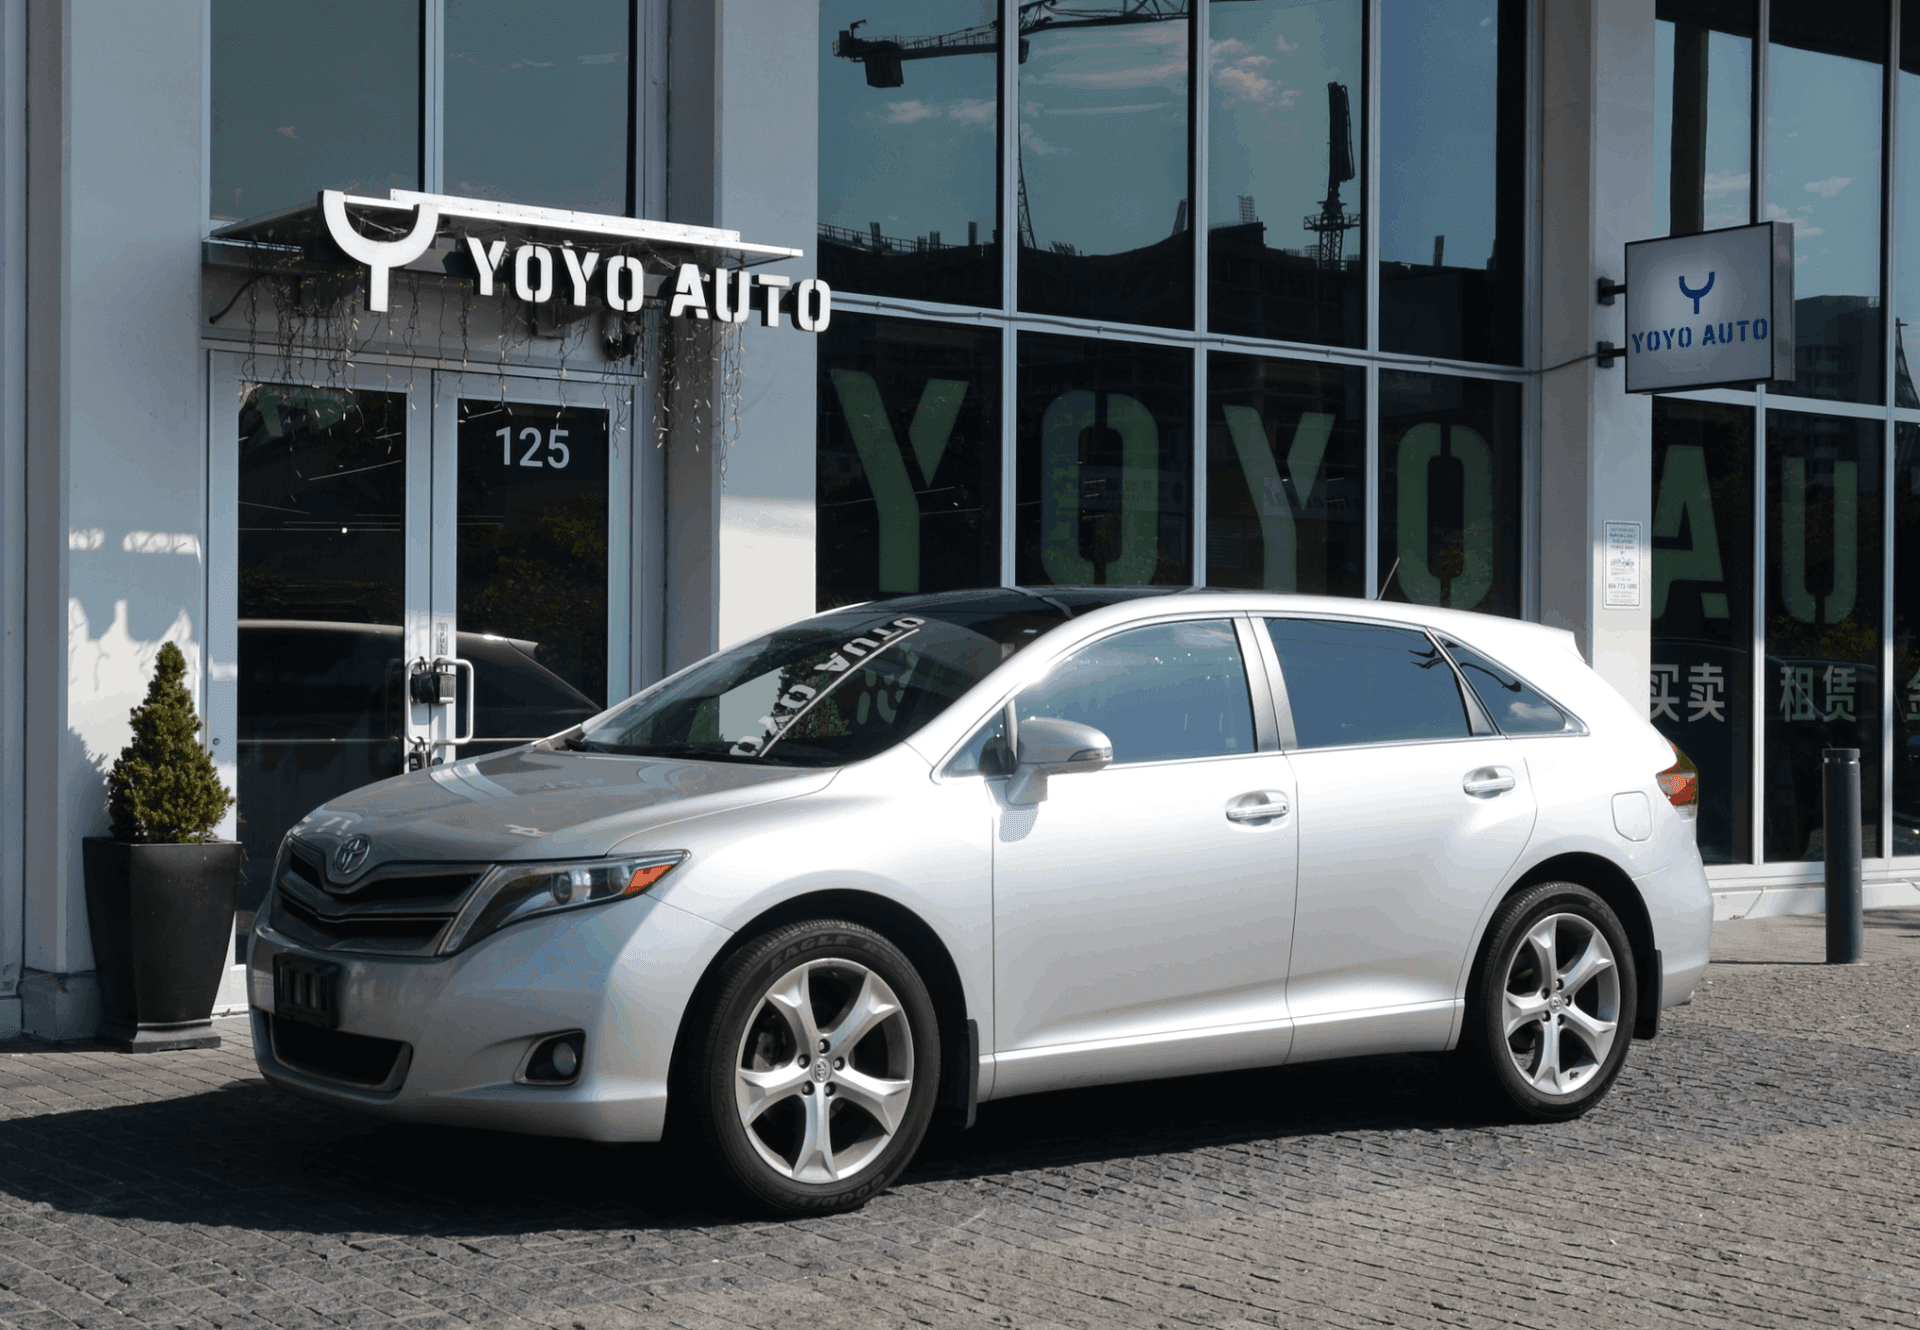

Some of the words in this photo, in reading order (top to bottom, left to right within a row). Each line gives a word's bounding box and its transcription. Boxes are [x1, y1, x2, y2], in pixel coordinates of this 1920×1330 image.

[465, 236, 645, 313] YOYO
[670, 262, 832, 332] AUTO
[1631, 326, 1693, 354] YOYO
[1702, 317, 1769, 346] AUTO
[495, 426, 571, 470] 125
[830, 368, 1494, 611] YOYO
[1650, 661, 1726, 723] 买卖
[1779, 664, 1857, 723] 租赁
[771, 935, 851, 971] EAGLE
